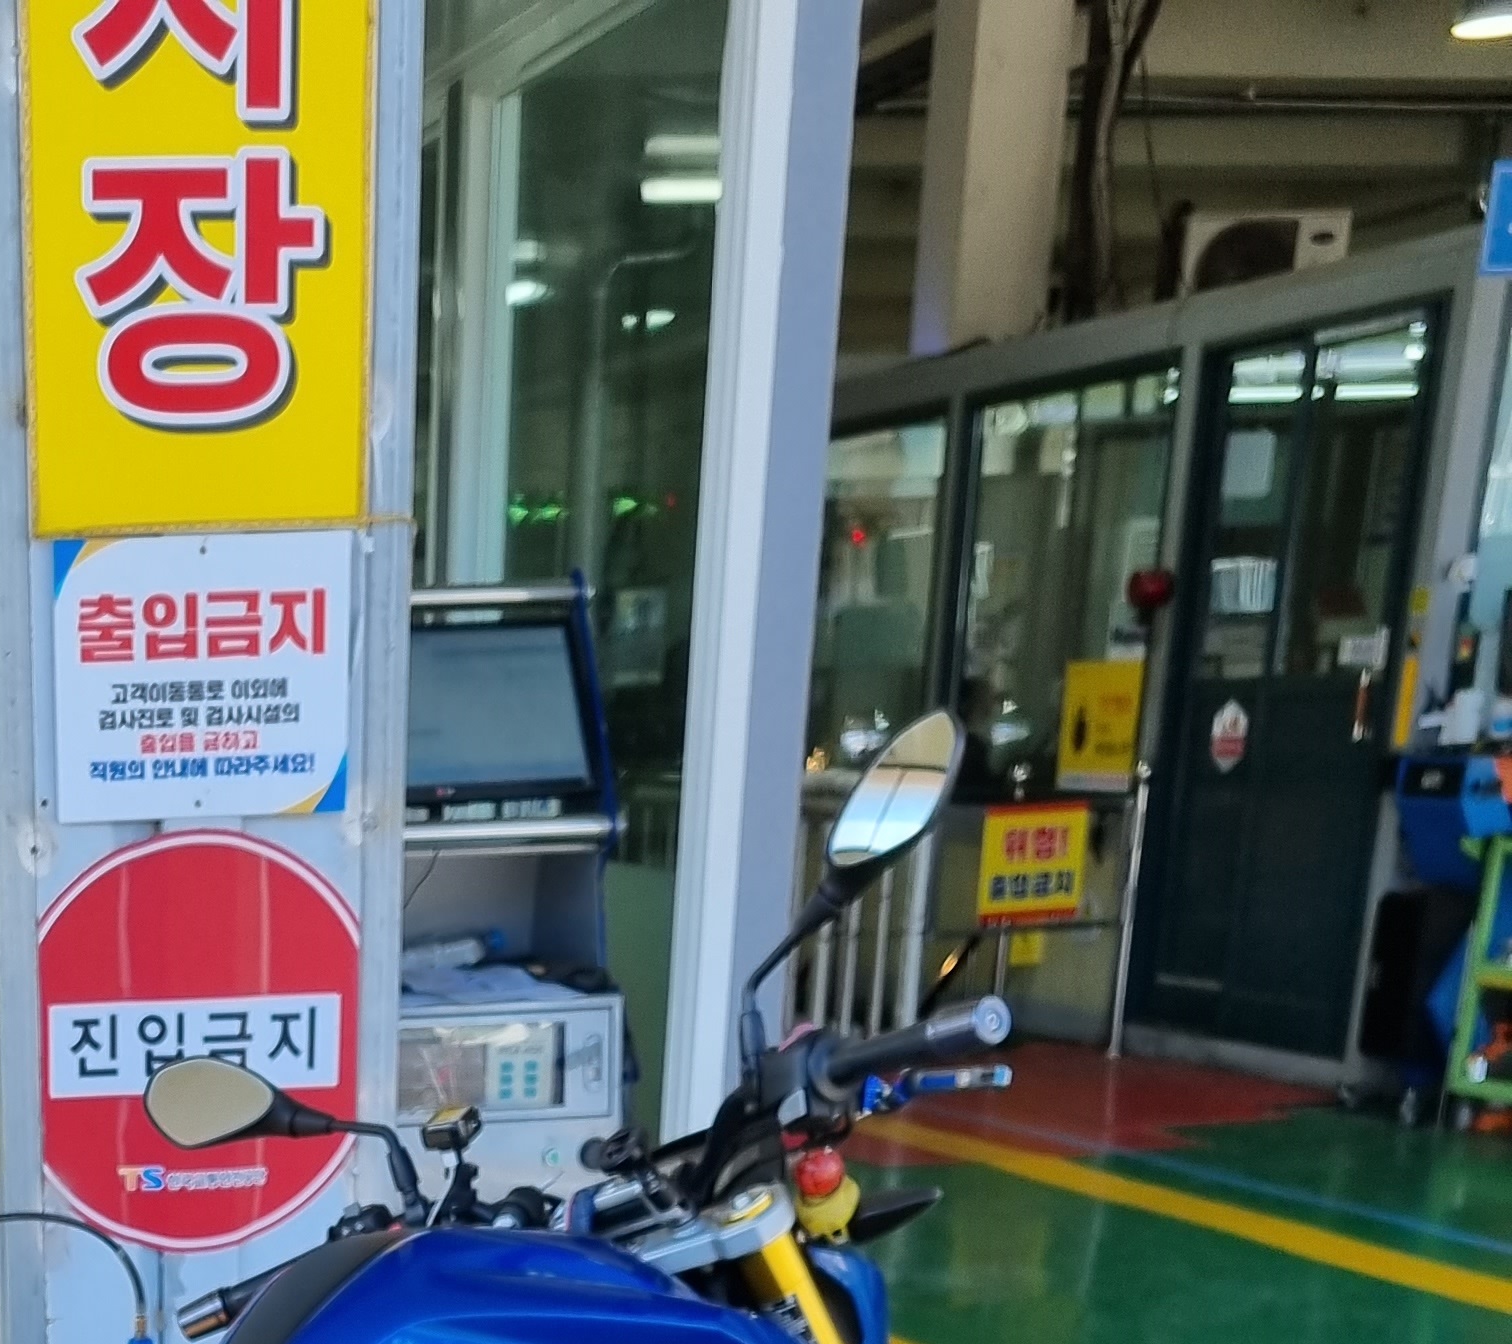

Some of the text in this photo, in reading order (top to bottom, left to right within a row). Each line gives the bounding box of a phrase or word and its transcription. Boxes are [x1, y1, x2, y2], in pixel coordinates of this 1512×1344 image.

[78, 588, 327, 664] 출입금지
[231, 678, 288, 700] 이외에
[99, 703, 300, 730] 검사진로 및 검사시설의
[203, 730, 258, 751] 금하고
[90, 753, 315, 781] 직원의 안내에 따라주세요!
[69, 1005, 317, 1078] 진입금지
[118, 1166, 164, 1191] TS
